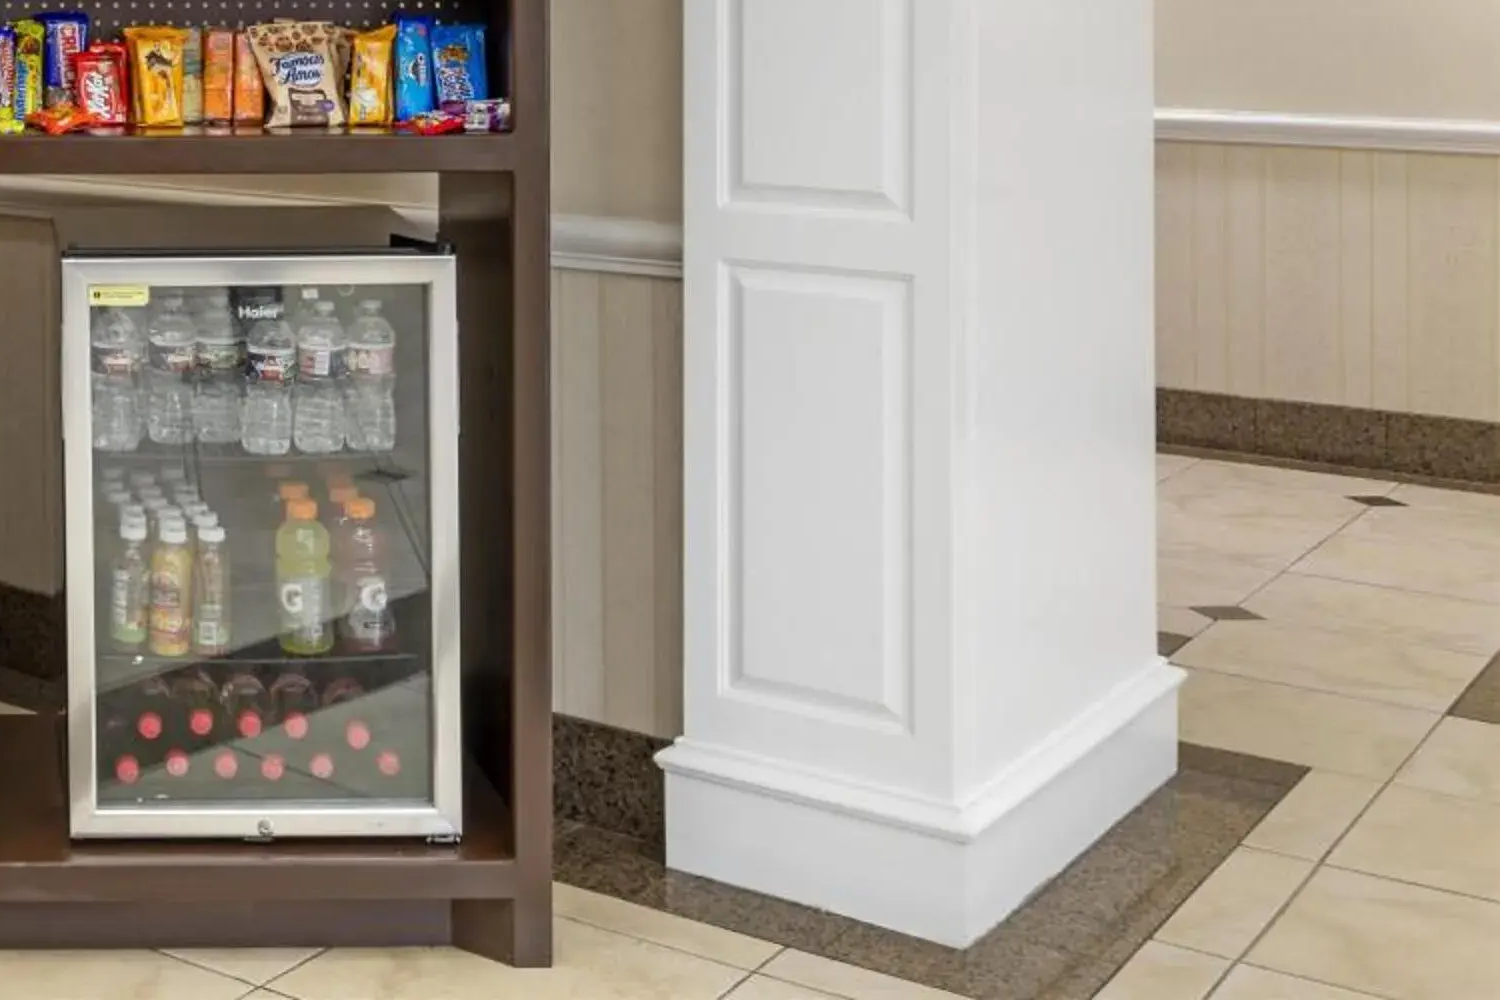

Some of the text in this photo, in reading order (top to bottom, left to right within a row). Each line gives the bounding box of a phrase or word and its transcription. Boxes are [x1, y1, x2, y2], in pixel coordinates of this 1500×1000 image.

[269, 53, 325, 77] Famous
[279, 69, 322, 85] Amos
[238, 305, 280, 319] Haier
[281, 583, 302, 614] G
